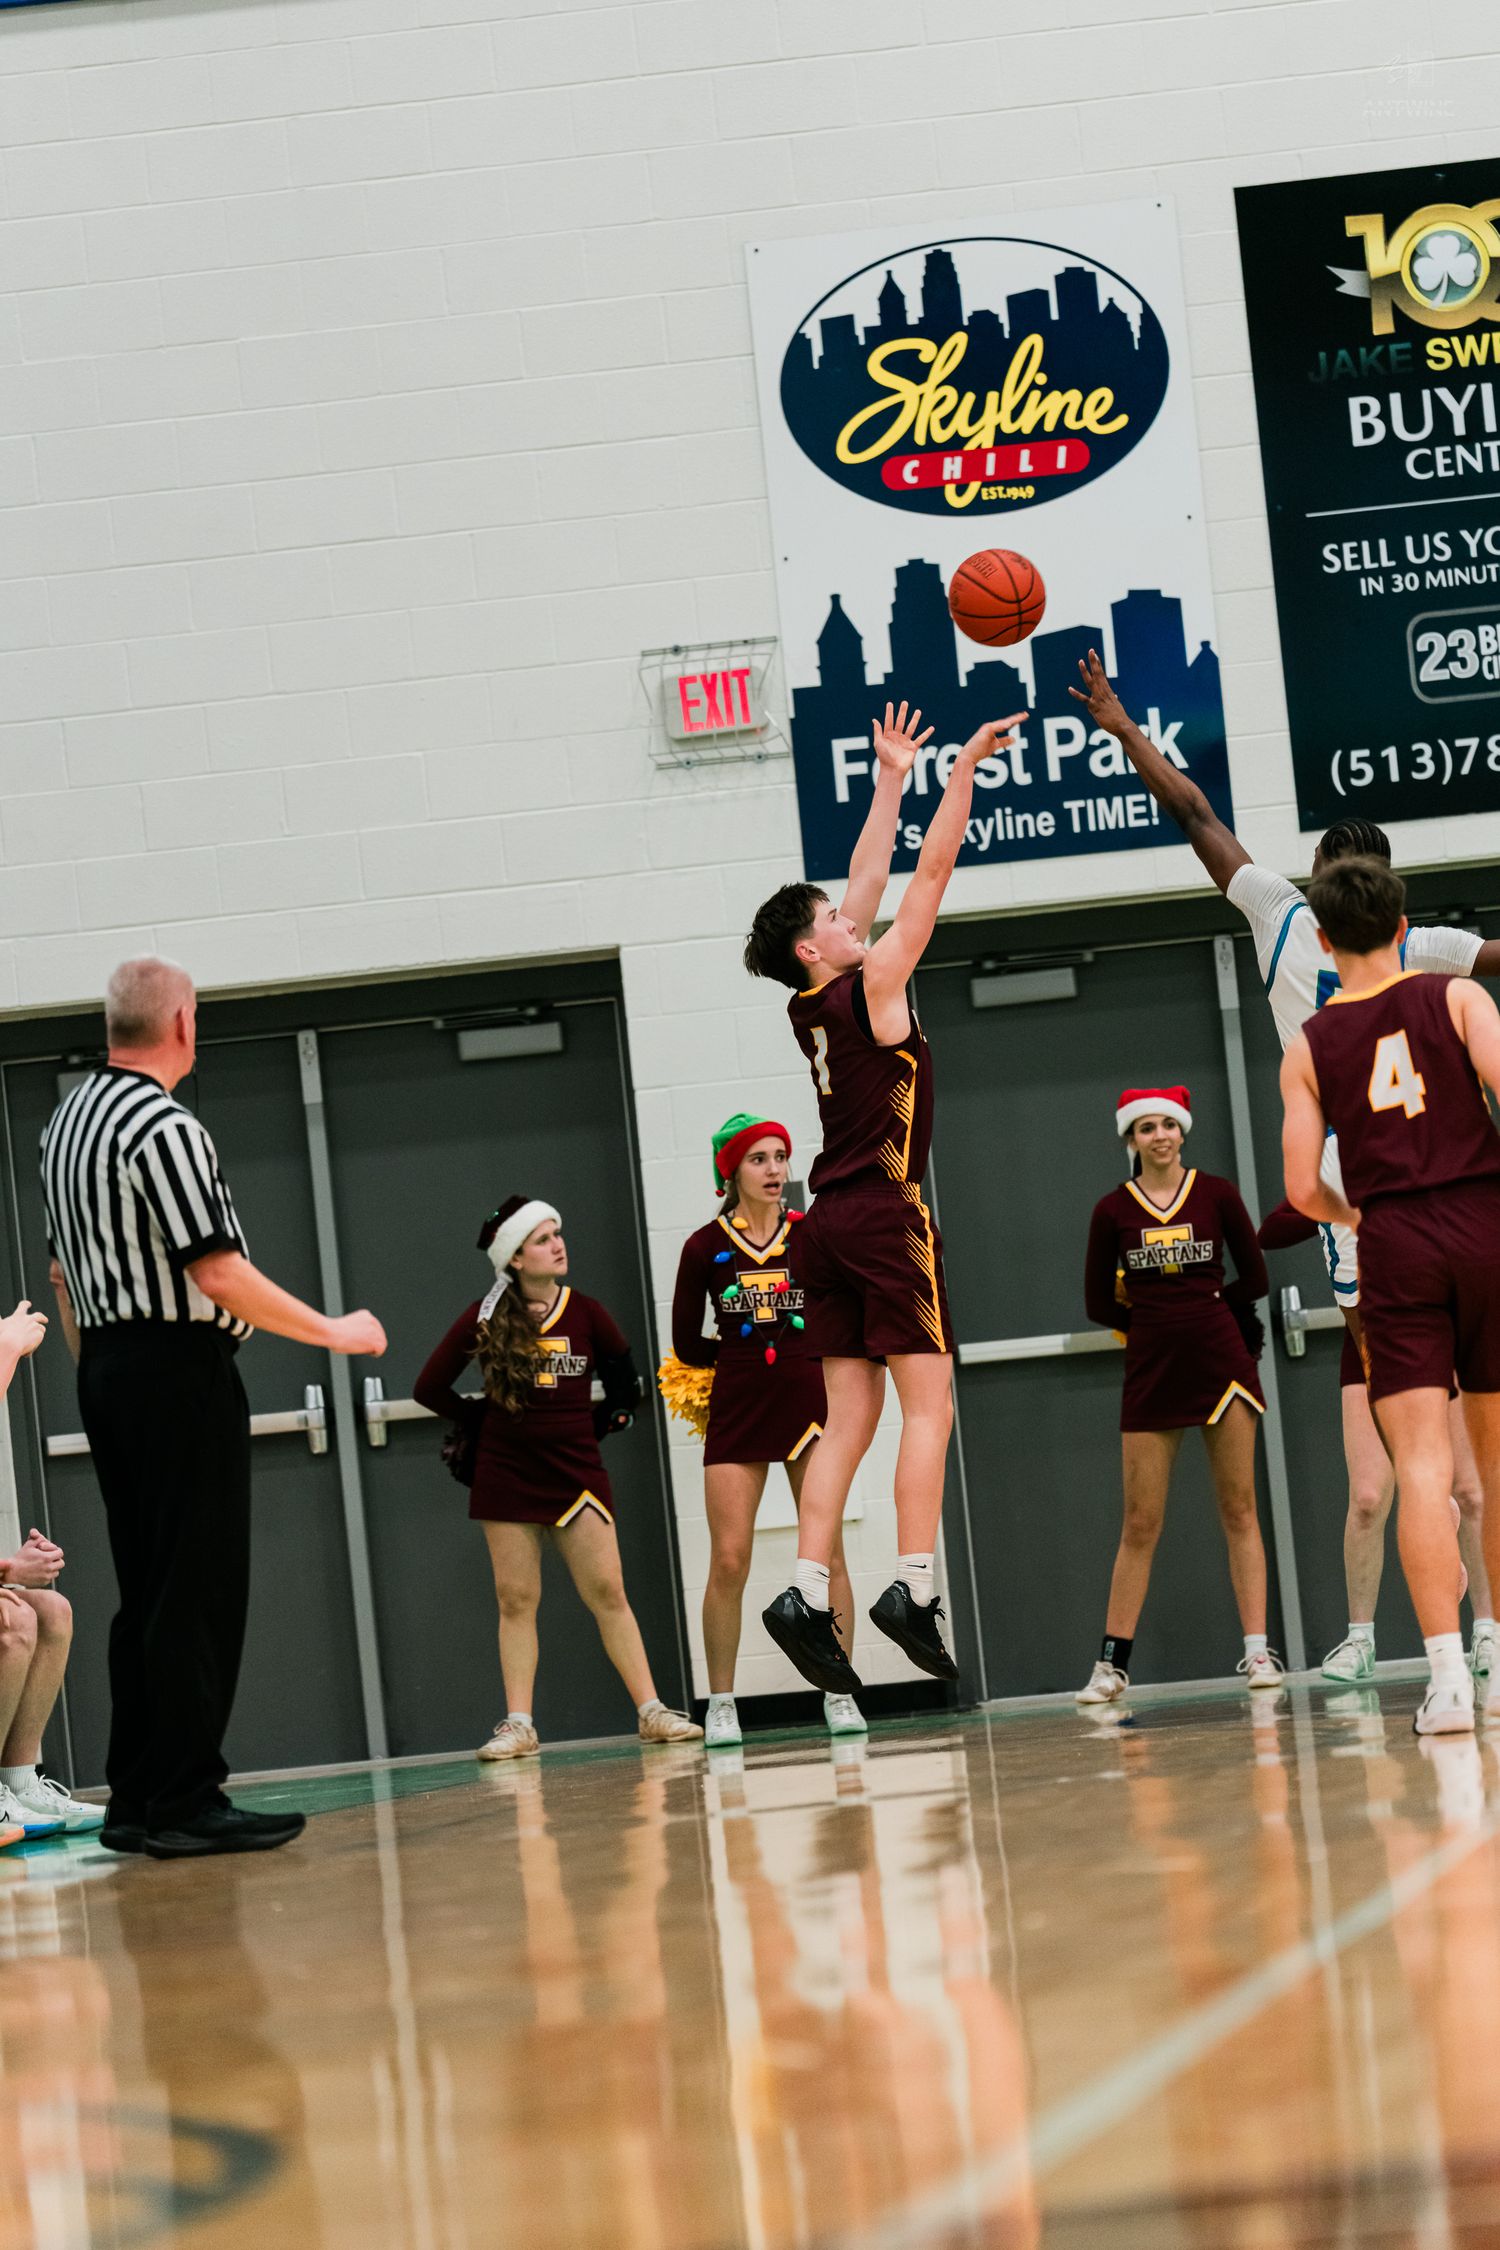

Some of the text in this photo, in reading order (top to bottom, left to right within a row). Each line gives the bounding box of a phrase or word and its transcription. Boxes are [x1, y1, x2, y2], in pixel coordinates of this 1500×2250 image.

[1307, 341, 1415, 384] JAKE
[836, 330, 1130, 509] Skyline
[1348, 382, 1498, 448] BUYI
[902, 445, 1068, 485] CHILI
[1405, 440, 1500, 481] CENT
[1321, 538, 1396, 574] SELL
[1405, 531, 1453, 565] US
[1360, 563, 1500, 597] IN 30 MINUT
[1415, 628, 1480, 683] 23
[678, 668, 752, 733] EXIT
[961, 806, 1056, 852] kyline
[1063, 793, 1160, 834] TIME!
[1367, 1028, 1427, 1120] 4
[1126, 1240, 1214, 1270] SPARTANS
